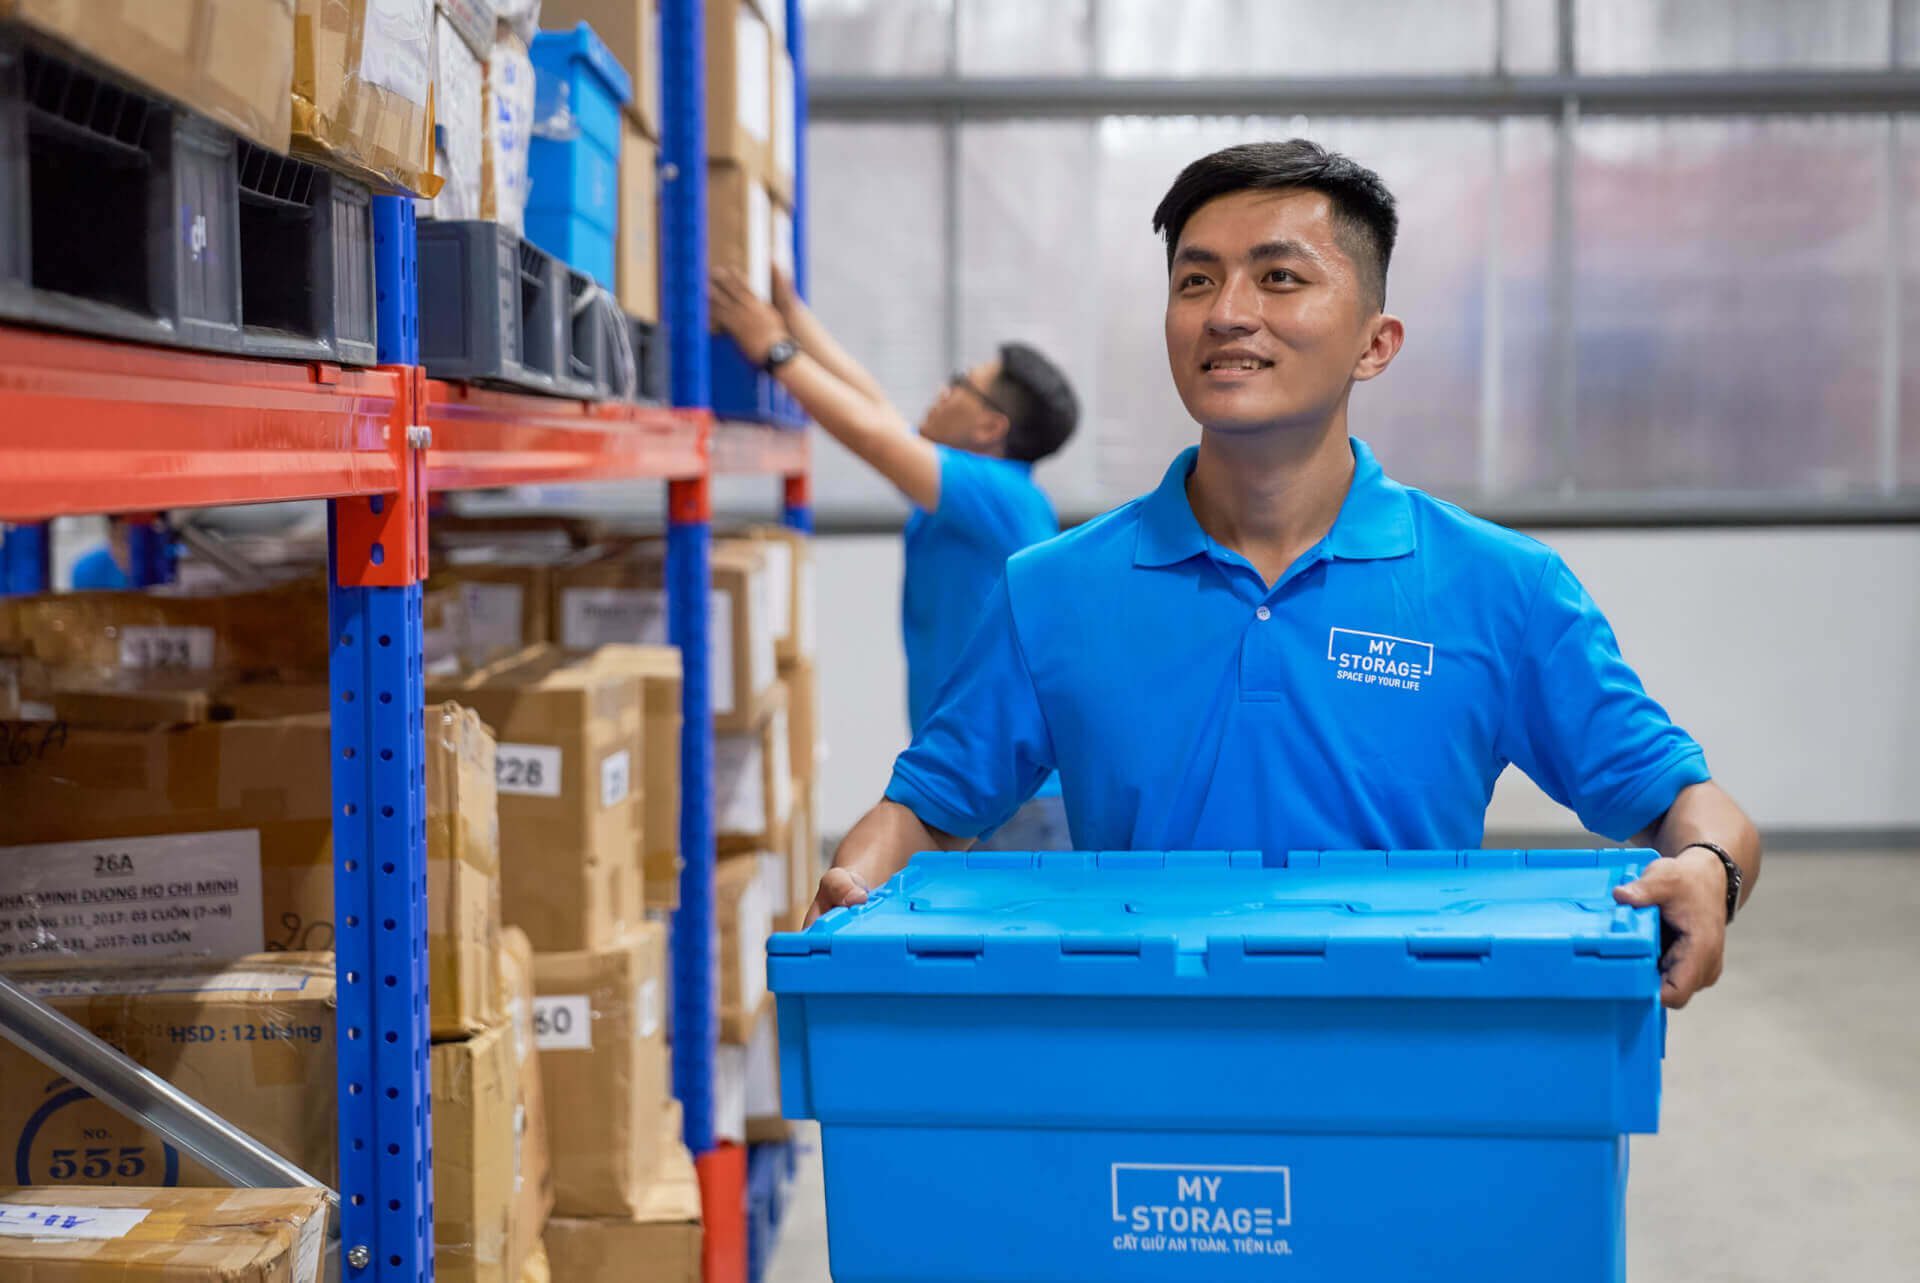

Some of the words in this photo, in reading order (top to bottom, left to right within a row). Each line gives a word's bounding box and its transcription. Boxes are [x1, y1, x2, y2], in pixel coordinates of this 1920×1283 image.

[1368, 640, 1396, 656] MY
[1338, 653, 1422, 679] STORAGE
[1337, 670, 1363, 682] SPACE
[1365, 674, 1377, 684] UP
[1378, 676, 1401, 688] YOUR
[1402, 680, 1420, 691] LIFE
[94, 853, 134, 872] 26A
[196, 879, 239, 896] MINH
[170, 1024, 216, 1044] HSD
[233, 1023, 257, 1042] 12
[83, 1128, 113, 1140] NO.
[49, 1147, 145, 1179] 555
[1177, 1176, 1222, 1202] MY
[1131, 1206, 1273, 1236] STORAGE
[1168, 1237, 1187, 1251] AN
